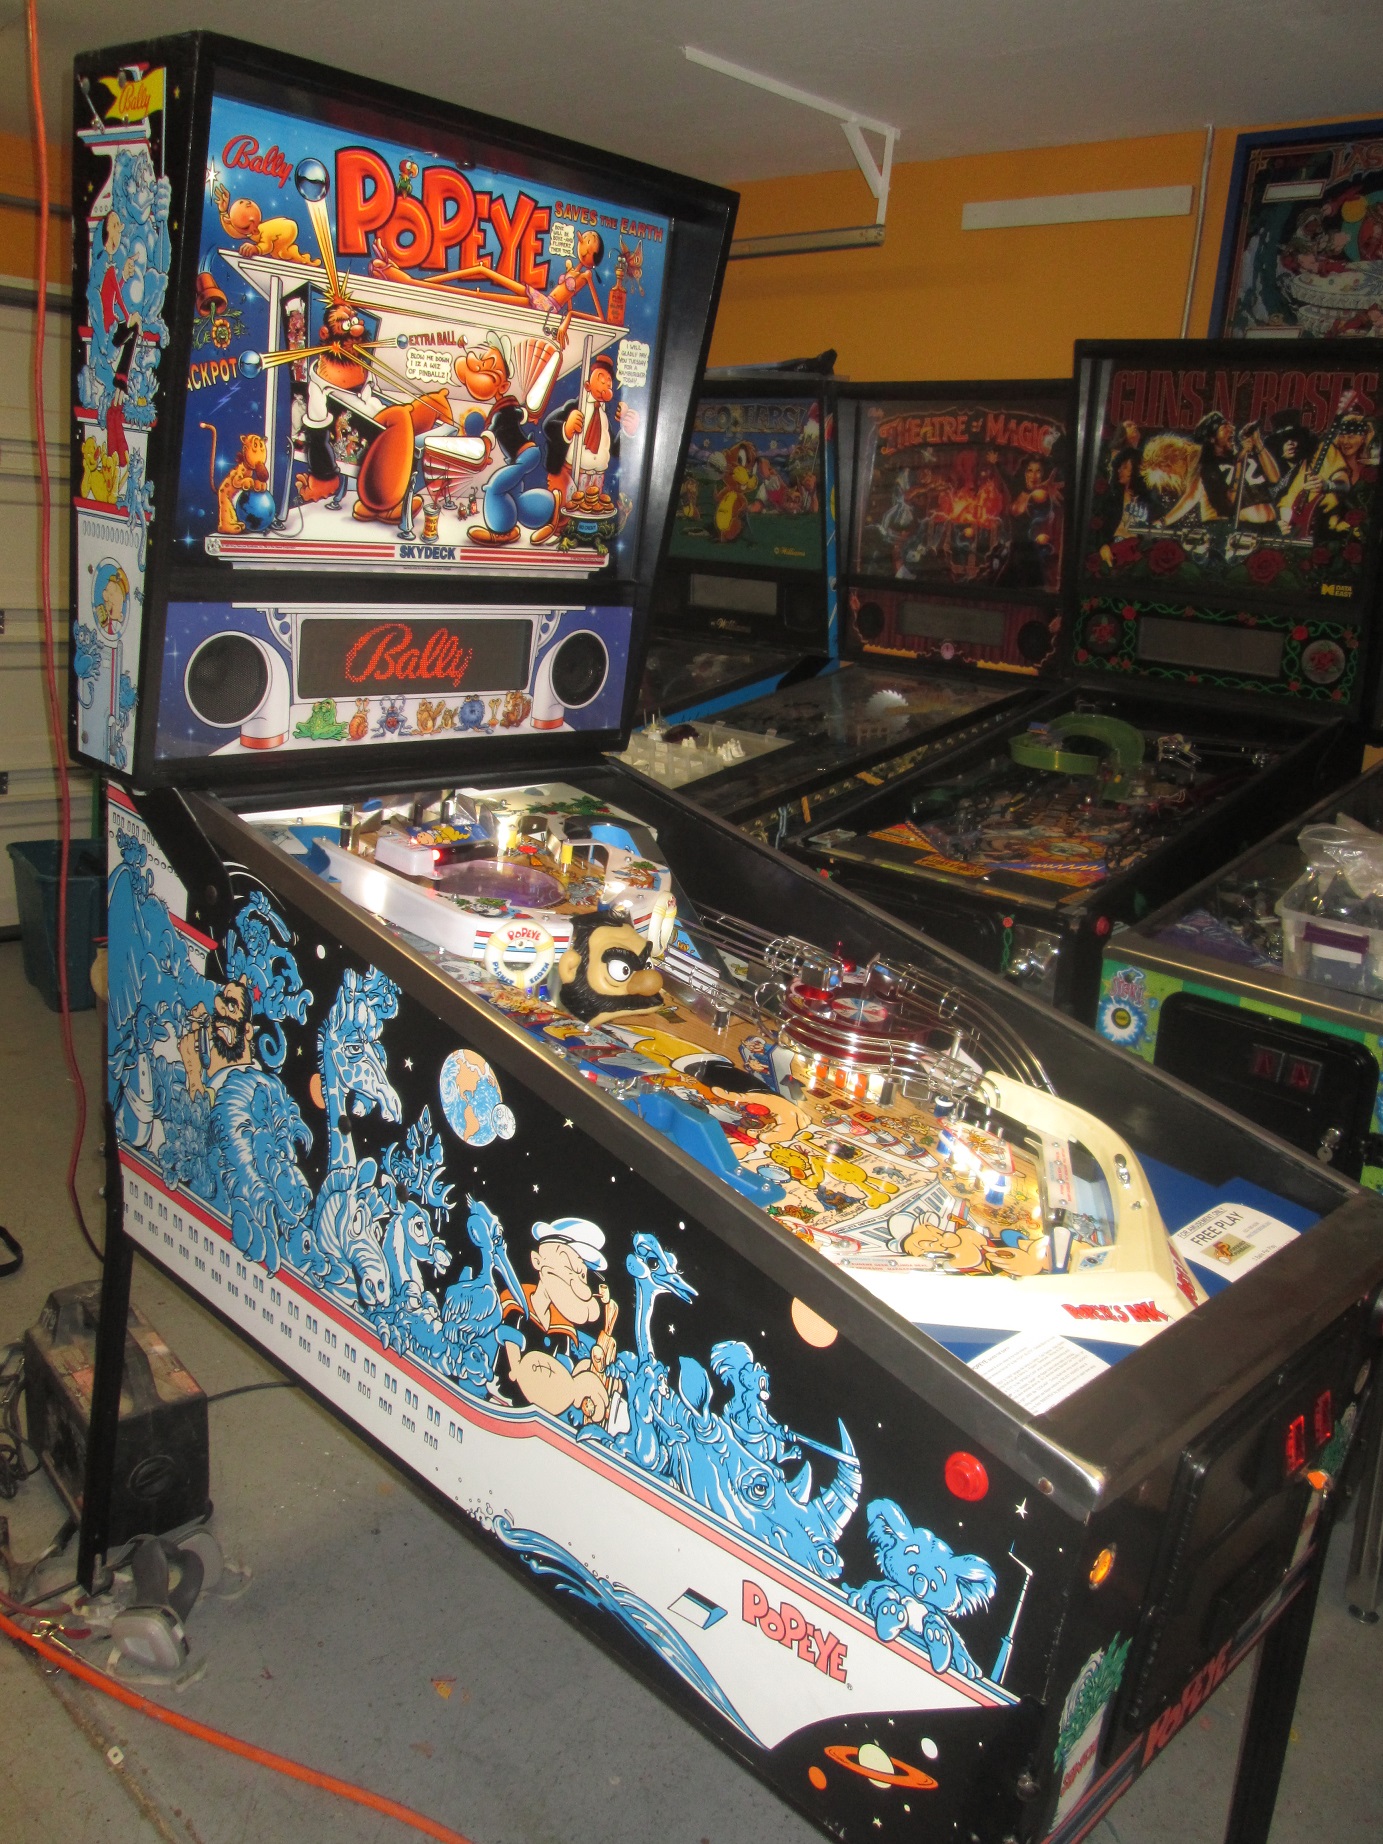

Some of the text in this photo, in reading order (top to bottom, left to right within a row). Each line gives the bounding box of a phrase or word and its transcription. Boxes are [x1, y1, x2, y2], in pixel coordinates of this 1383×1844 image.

[118, 84, 151, 115] Bally
[222, 134, 295, 189] Bally
[334, 145, 552, 291] POPEYE
[554, 200, 664, 243] SAVES THE EARTH
[409, 331, 457, 346] EXTRA BALL
[1109, 369, 1206, 429] GUNS
[1250, 370, 1380, 433] ROSES
[878, 415, 969, 456] THEATRE
[986, 413, 1055, 457] MAGIC
[399, 544, 457, 561] SKYDECK
[345, 622, 473, 687] Bally
[507, 927, 542, 942] POPEYE
[529, 962, 550, 985] EARTH
[1177, 1207, 1226, 1239] FOR AMUSEMENT ONLY
[1190, 1226, 1223, 1247] FREE
[1218, 1211, 1245, 1231] PLAY
[1061, 1300, 1170, 1324] POPEYE'S ARK
[742, 1579, 849, 1685] POPEYE
